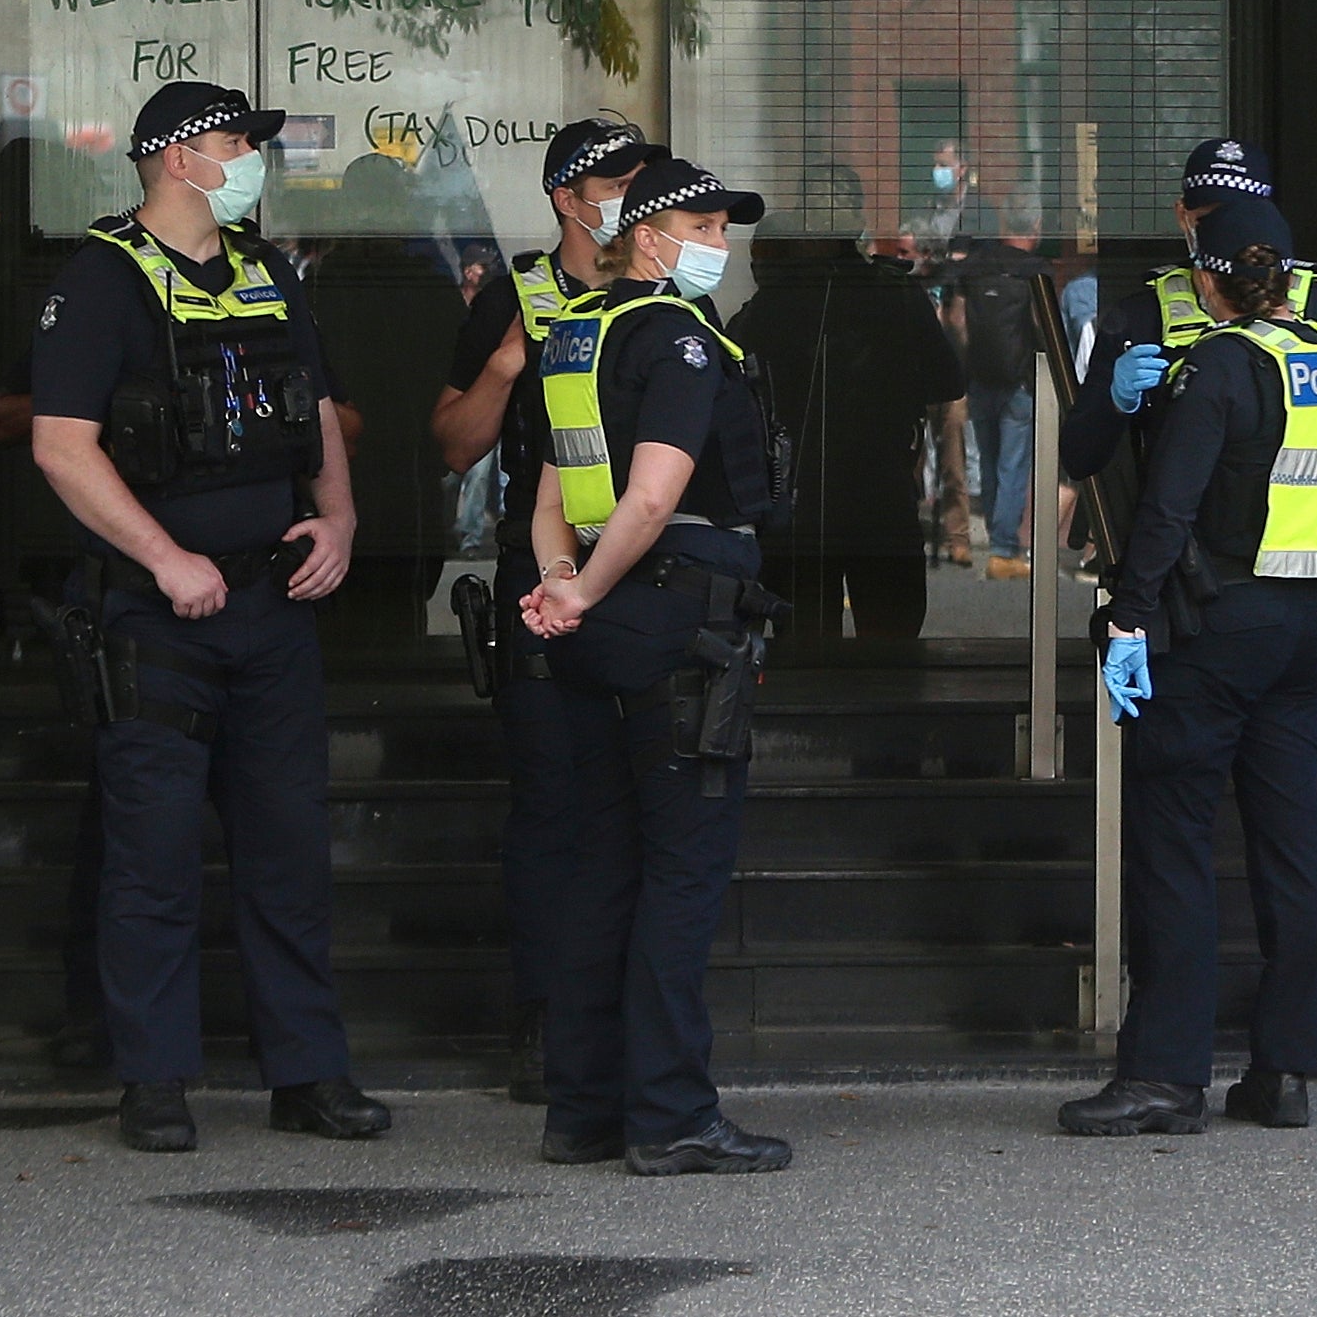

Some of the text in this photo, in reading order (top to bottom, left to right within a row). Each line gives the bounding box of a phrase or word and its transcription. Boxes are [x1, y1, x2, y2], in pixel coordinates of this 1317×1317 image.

[133, 39, 394, 84] FOR FREE
[239, 290, 277, 301] Police
